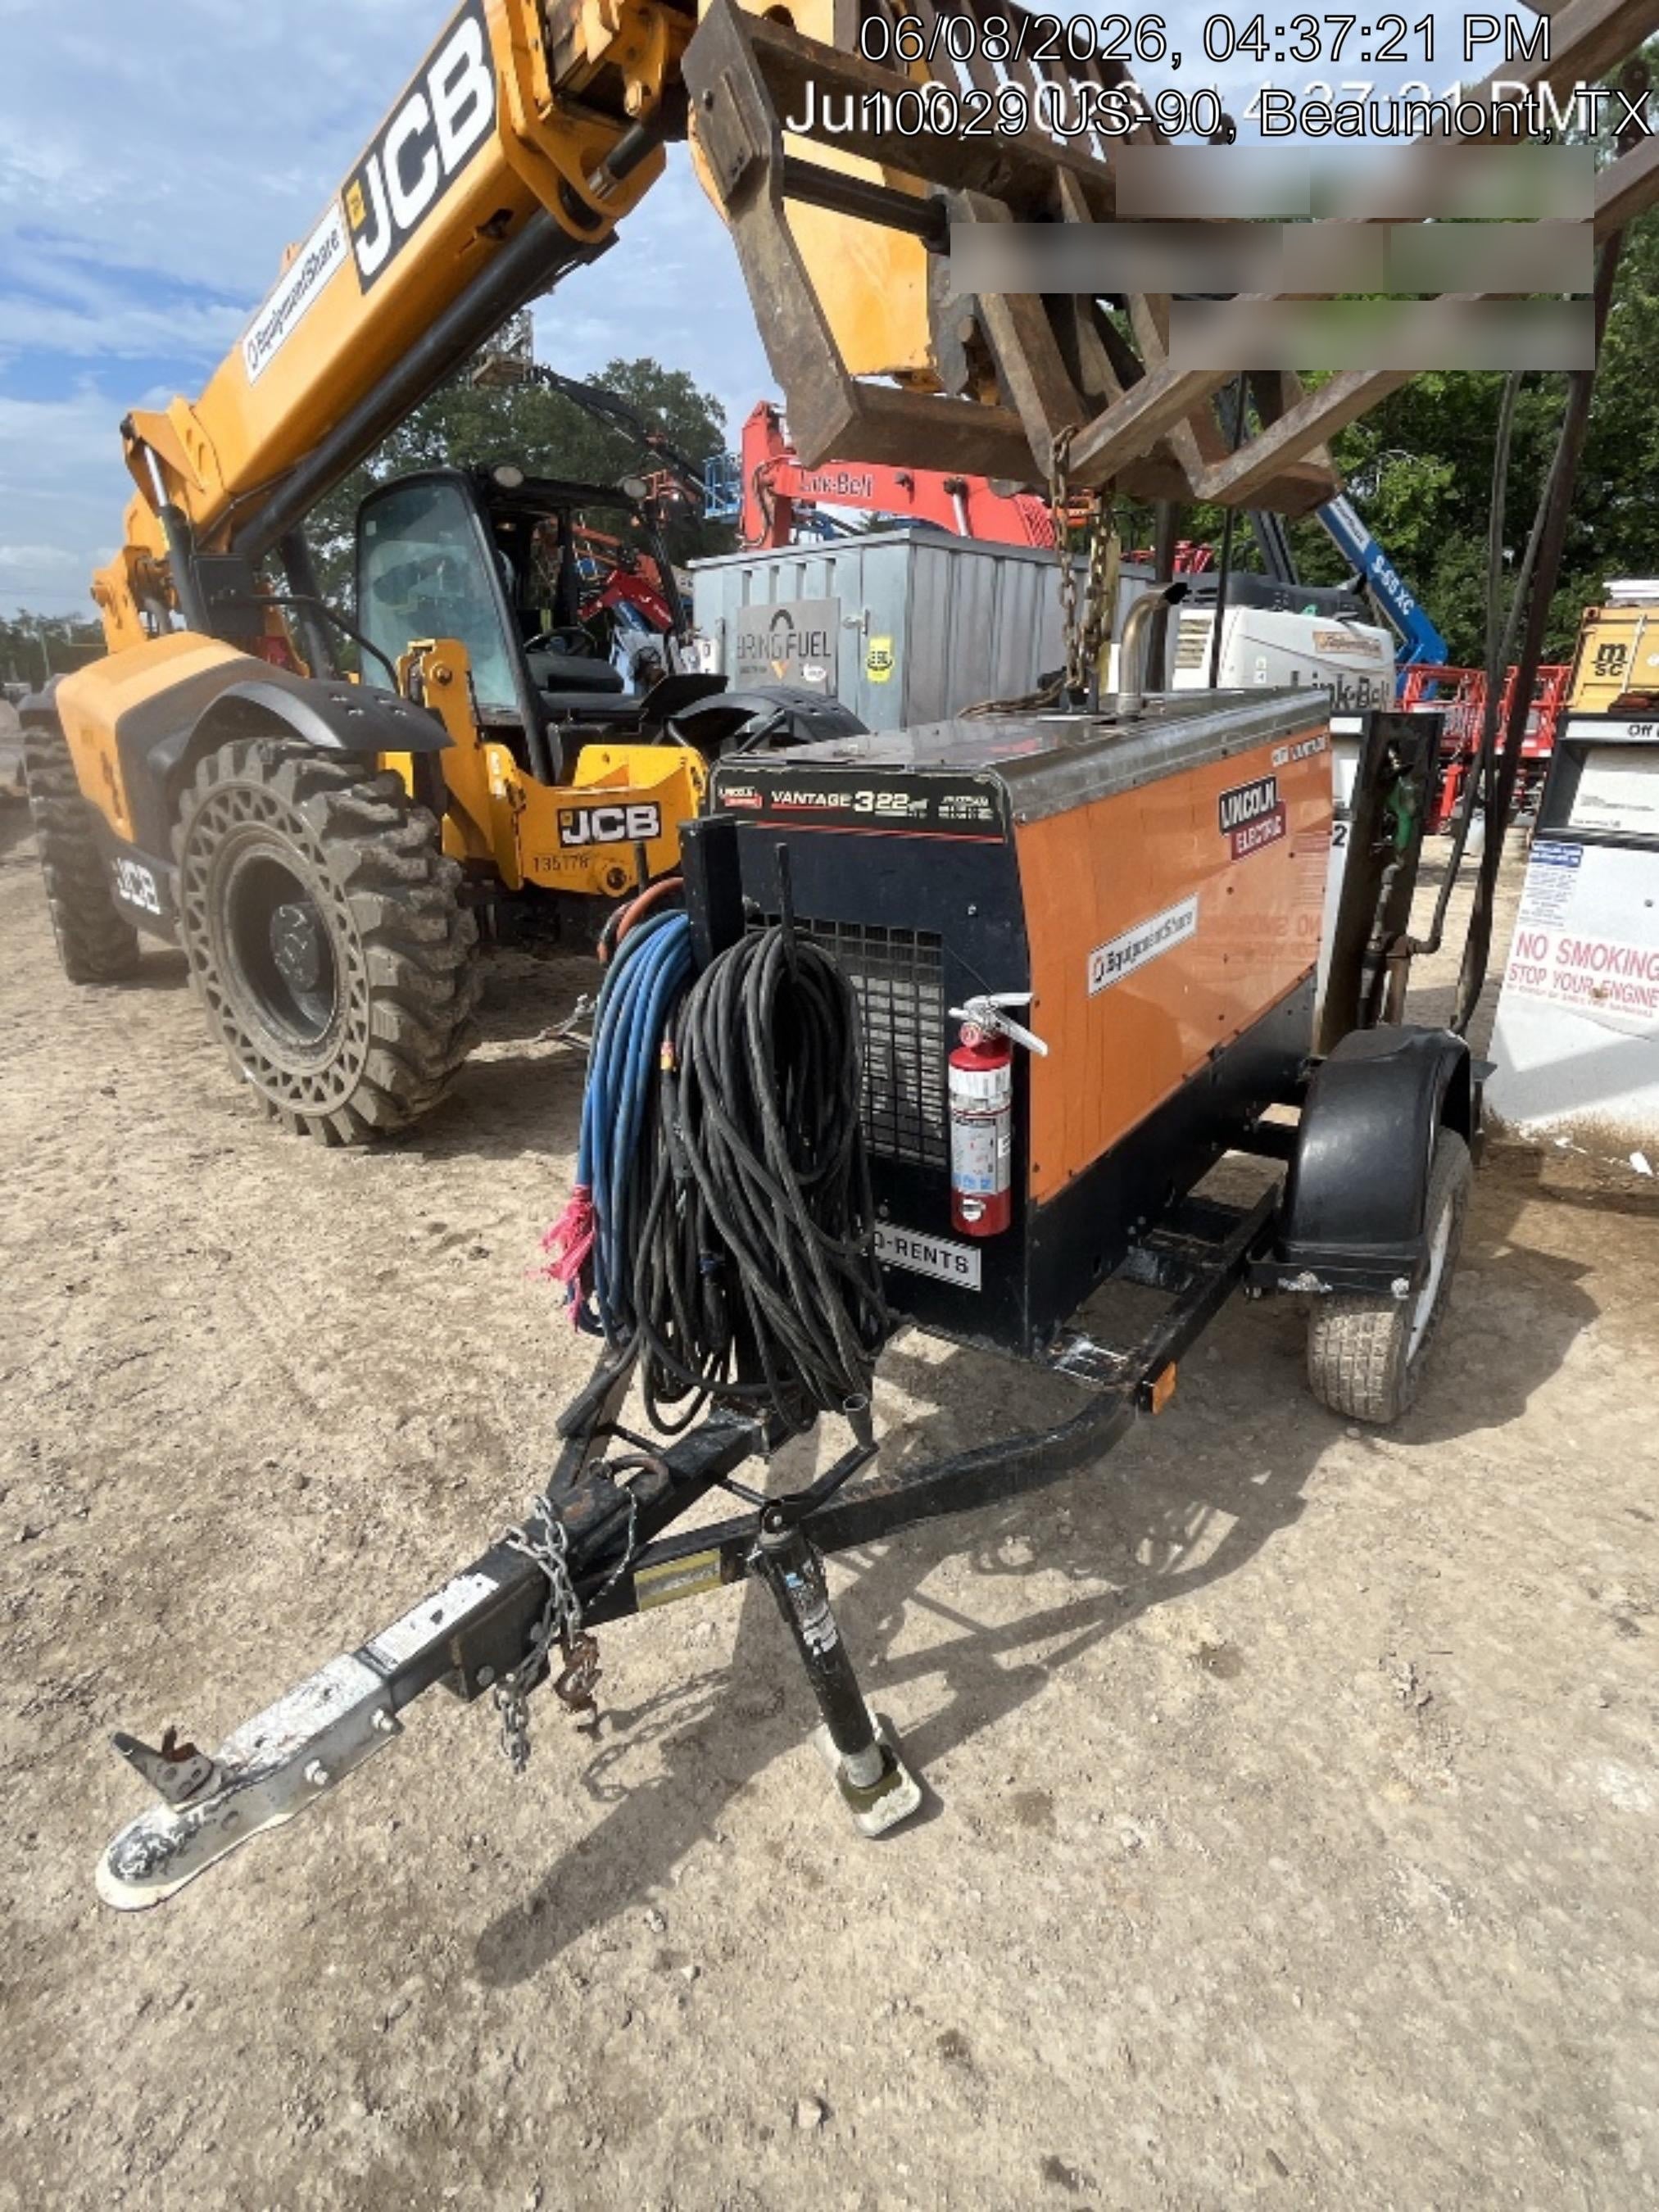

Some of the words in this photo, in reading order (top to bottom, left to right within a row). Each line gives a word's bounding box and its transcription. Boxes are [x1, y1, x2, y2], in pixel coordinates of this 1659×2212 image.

[355, 16, 493, 276] JCB
[255, 228, 339, 356] EquipmentShare
[786, 630, 832, 660] FUEL
[771, 790, 852, 807] VANTAGE
[854, 791, 909, 813] 322
[1221, 781, 1275, 829] LINCOLN
[561, 805, 660, 845] JCB
[1235, 815, 1282, 854] ELECTRIC
[1331, 823, 1348, 847] 2
[116, 857, 161, 916] JCB
[1106, 911, 1194, 975] EquipmentShare
[1516, 931, 1549, 961] NO
[1556, 939, 1659, 983] SMOKING
[1509, 963, 1547, 986] STOP
[1553, 970, 1594, 994] YOUR
